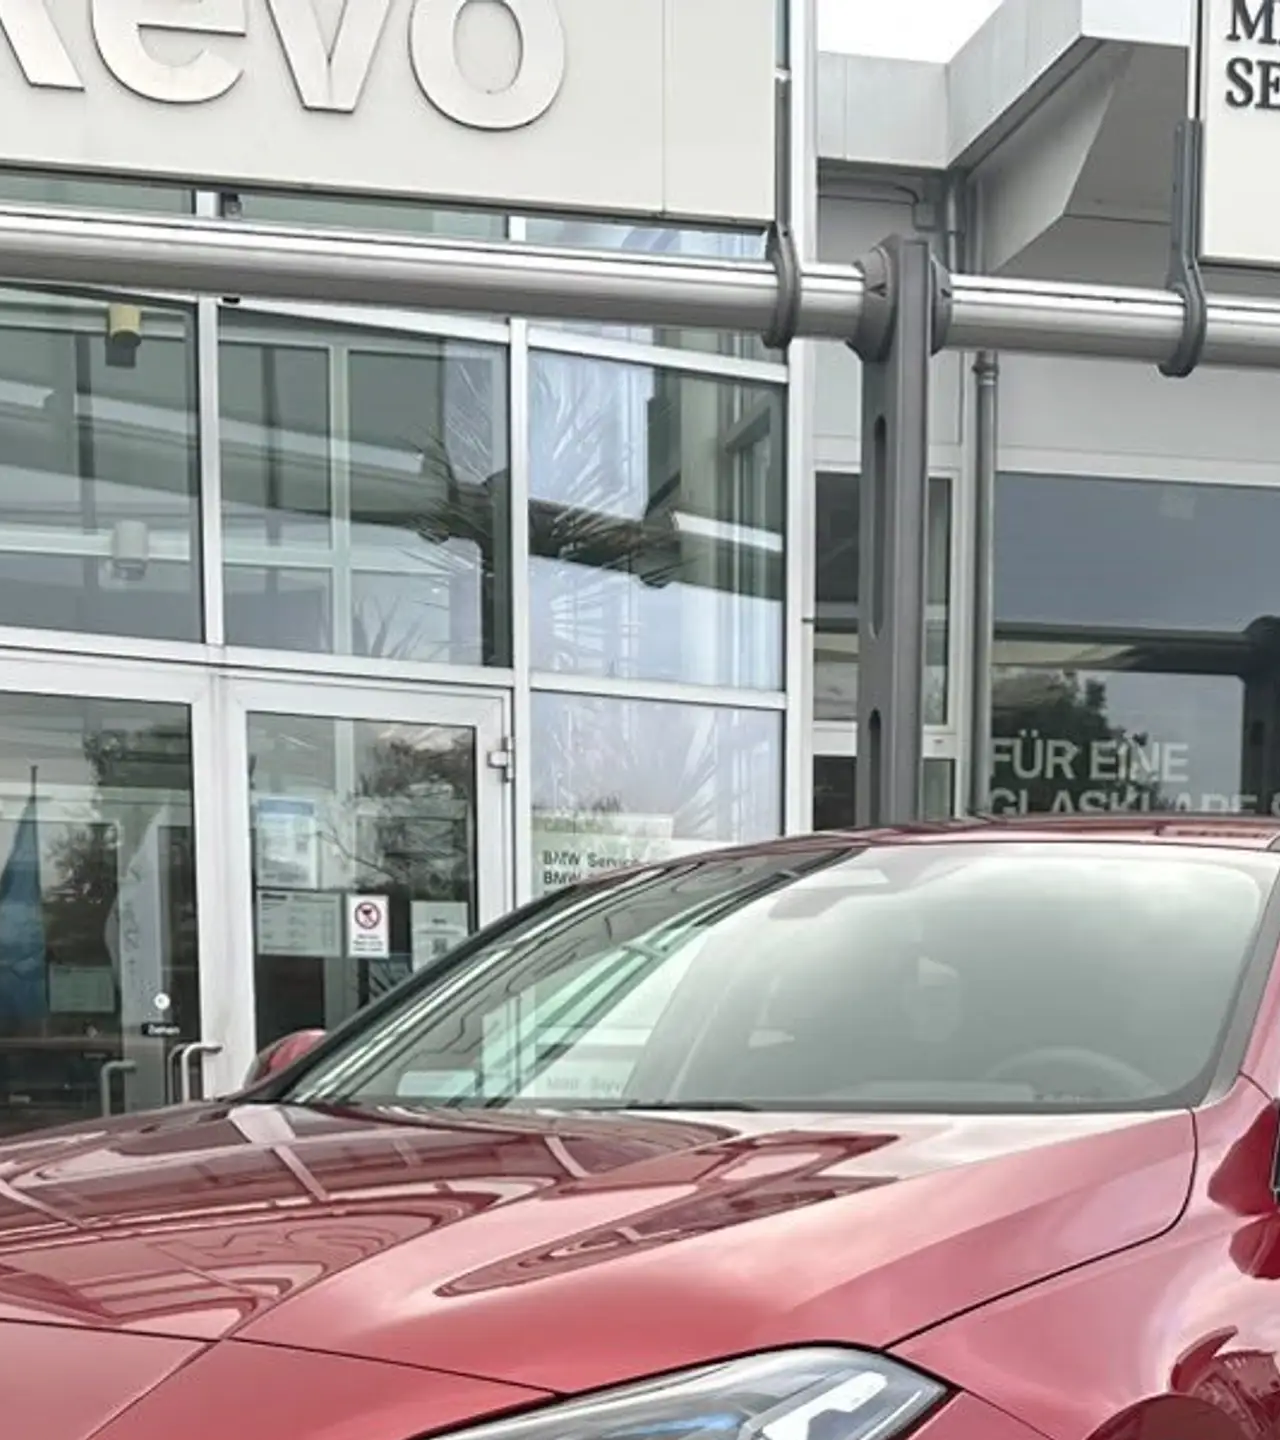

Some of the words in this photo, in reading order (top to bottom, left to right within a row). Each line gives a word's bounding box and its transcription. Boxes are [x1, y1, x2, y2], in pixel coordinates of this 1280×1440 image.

[992, 729, 1076, 780] FÜR
[1090, 740, 1189, 782] EINE
[543, 850, 580, 866] BMW
